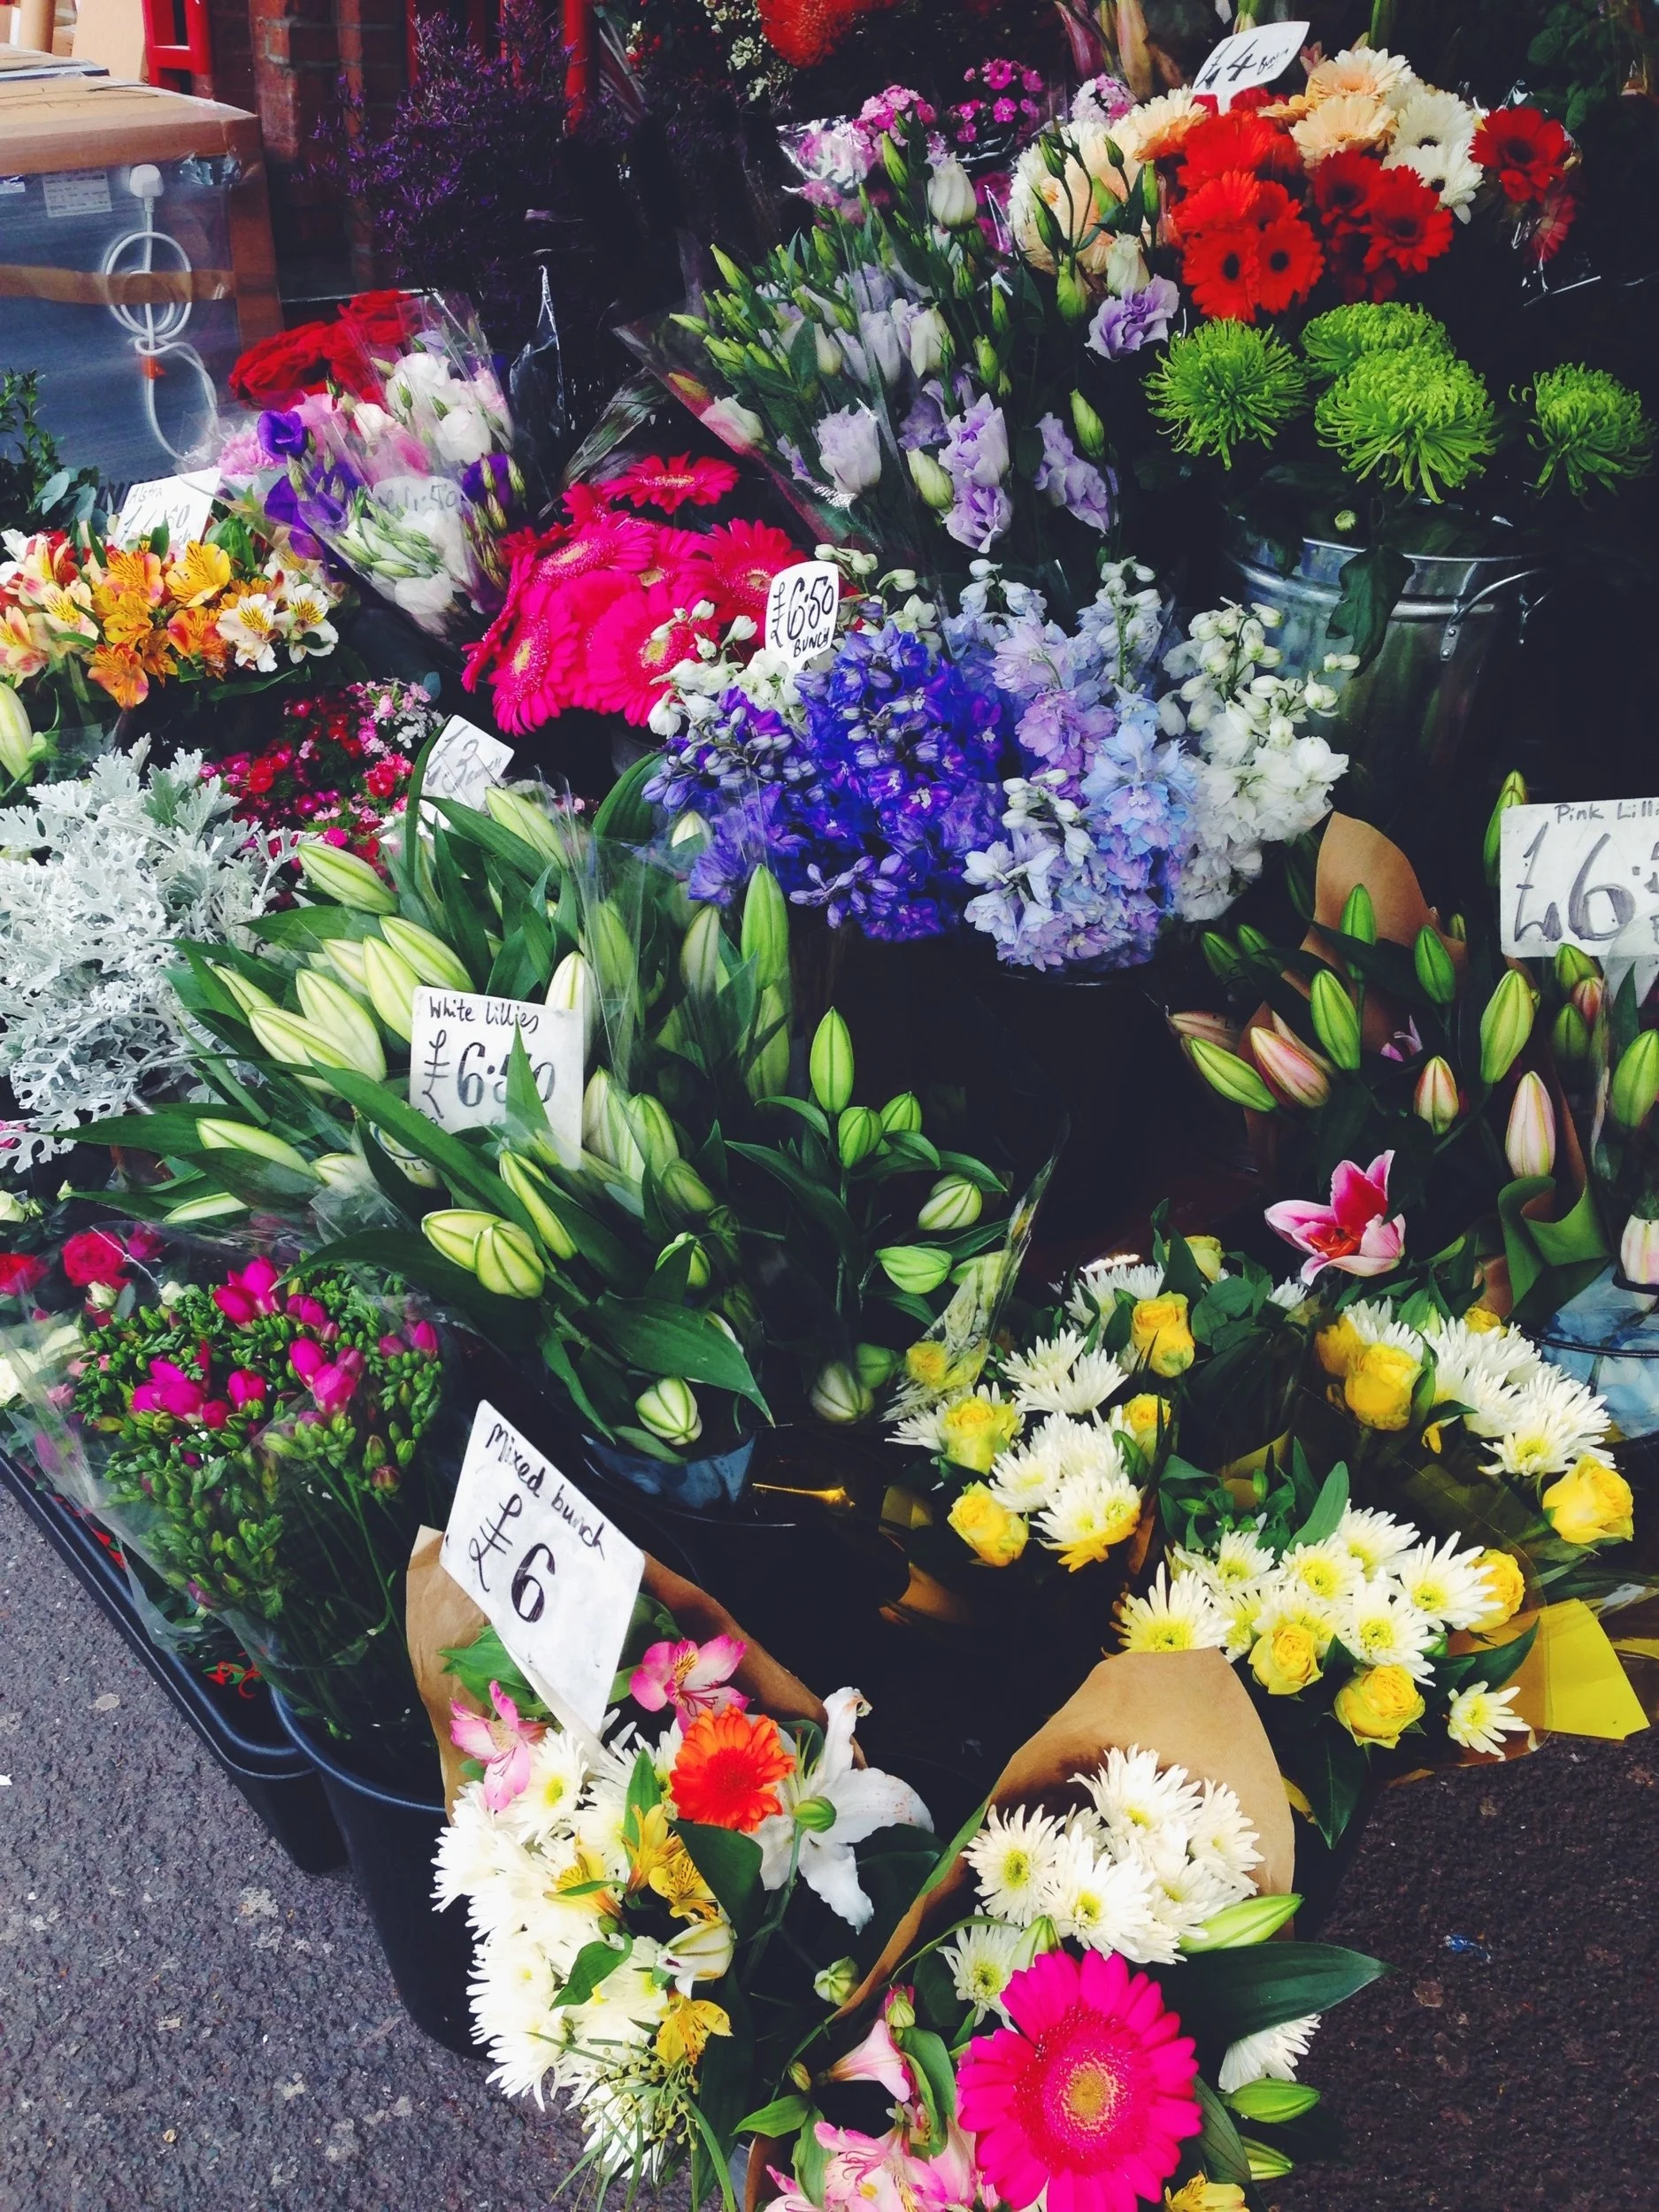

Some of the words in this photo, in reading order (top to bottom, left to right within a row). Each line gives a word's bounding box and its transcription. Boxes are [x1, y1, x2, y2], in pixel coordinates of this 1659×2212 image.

[771, 576, 834, 648] £6.50
[794, 626, 830, 658] BUNCH
[1555, 803, 1604, 824] Pink
[429, 996, 476, 1022] White
[485, 1423, 546, 1498] Mixed
[551, 1484, 605, 1561] bunch
